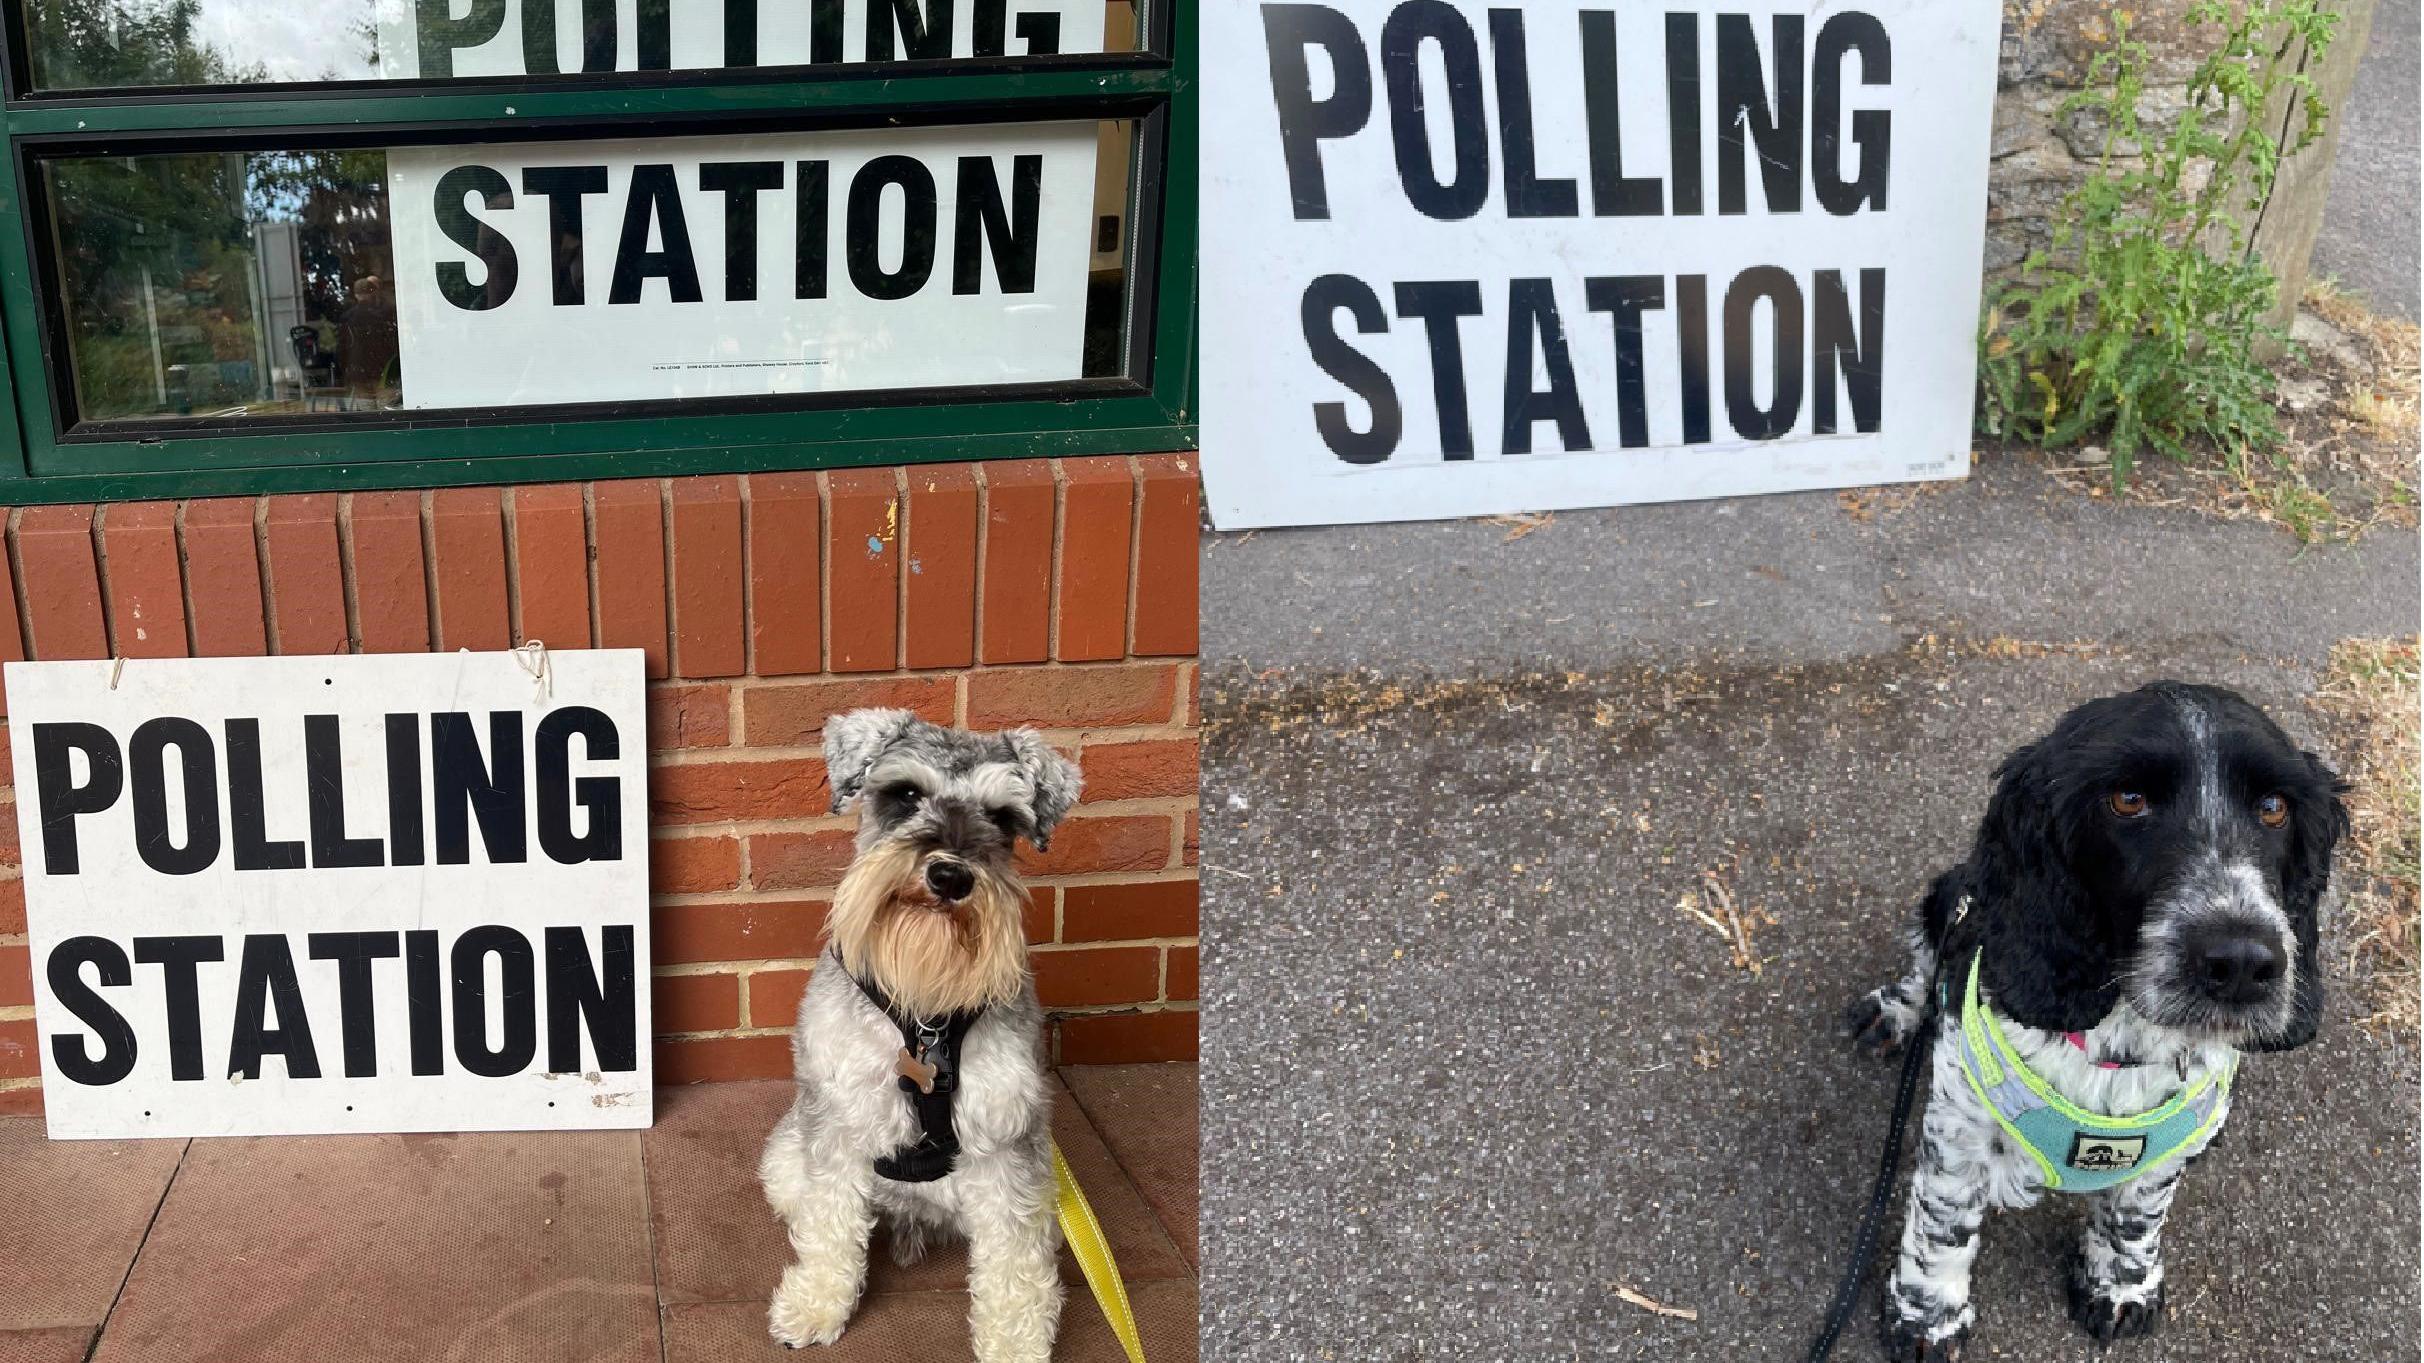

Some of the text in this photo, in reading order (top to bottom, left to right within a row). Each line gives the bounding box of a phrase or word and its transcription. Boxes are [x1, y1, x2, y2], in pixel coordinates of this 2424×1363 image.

[1262, 0, 1892, 221] POLLING
[434, 154, 1043, 311] STATION
[1301, 265, 1887, 465] STATION
[33, 705, 623, 876] POLLING
[47, 924, 637, 1086] STATION
